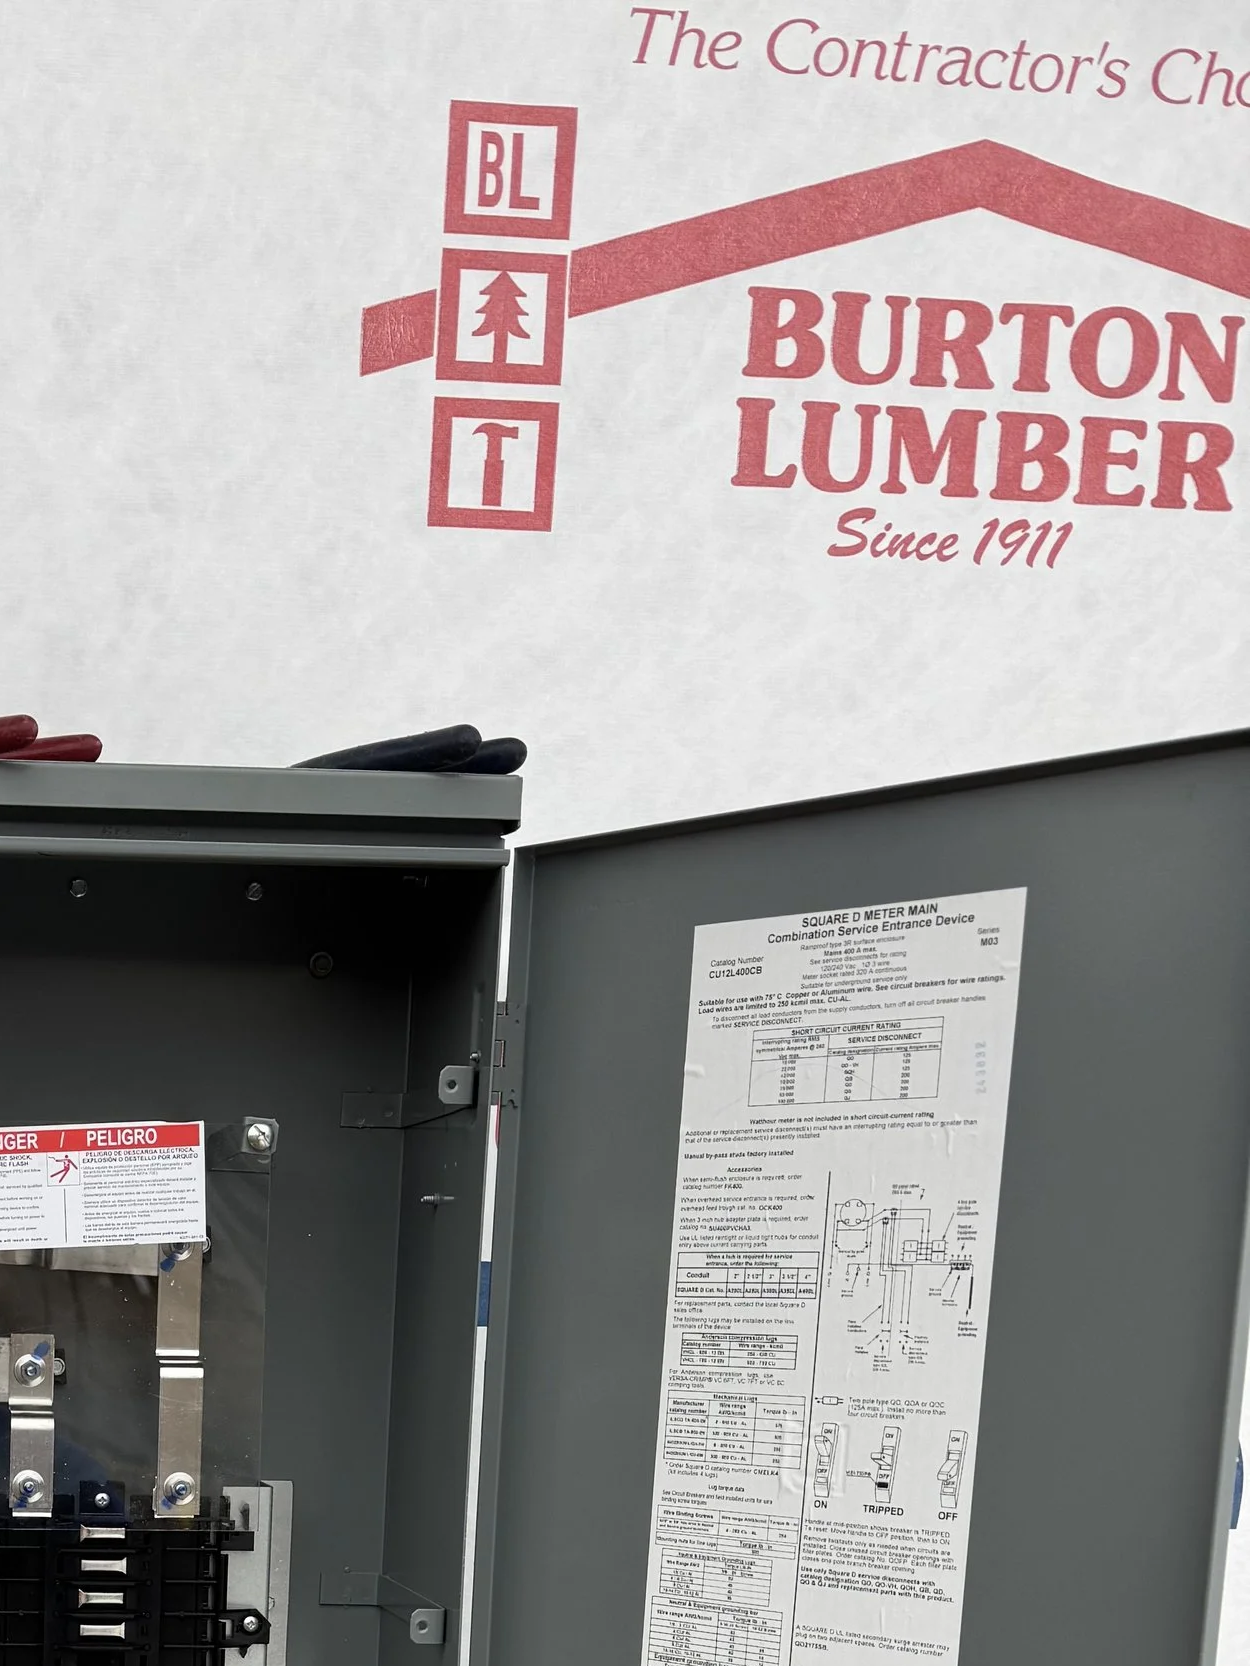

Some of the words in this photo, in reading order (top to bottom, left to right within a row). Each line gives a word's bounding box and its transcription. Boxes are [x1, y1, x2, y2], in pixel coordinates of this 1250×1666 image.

[630, 8, 742, 69] The
[766, 17, 1130, 99] Contractor's
[477, 131, 541, 210] BL
[741, 286, 1247, 403] BURTON
[730, 397, 1235, 511] LUMBER
[826, 507, 959, 565] Since
[974, 518, 1075, 569] 1911
[802, 913, 849, 927] SQUARE
[852, 912, 861, 922] D
[864, 907, 904, 921] METER
[908, 903, 938, 916] MAIN
[767, 928, 835, 944] Combination
[838, 923, 878, 936] Service
[882, 918, 932, 932] Entrance
[935, 913, 975, 926] Device
[980, 937, 999, 946] M03
[709, 966, 763, 979] CU12L400CB
[86, 1128, 157, 1147] PELIGRO
[813, 1500, 828, 1509] ON
[863, 1504, 904, 1516] TRIPPED
[938, 1512, 958, 1521] OFF
